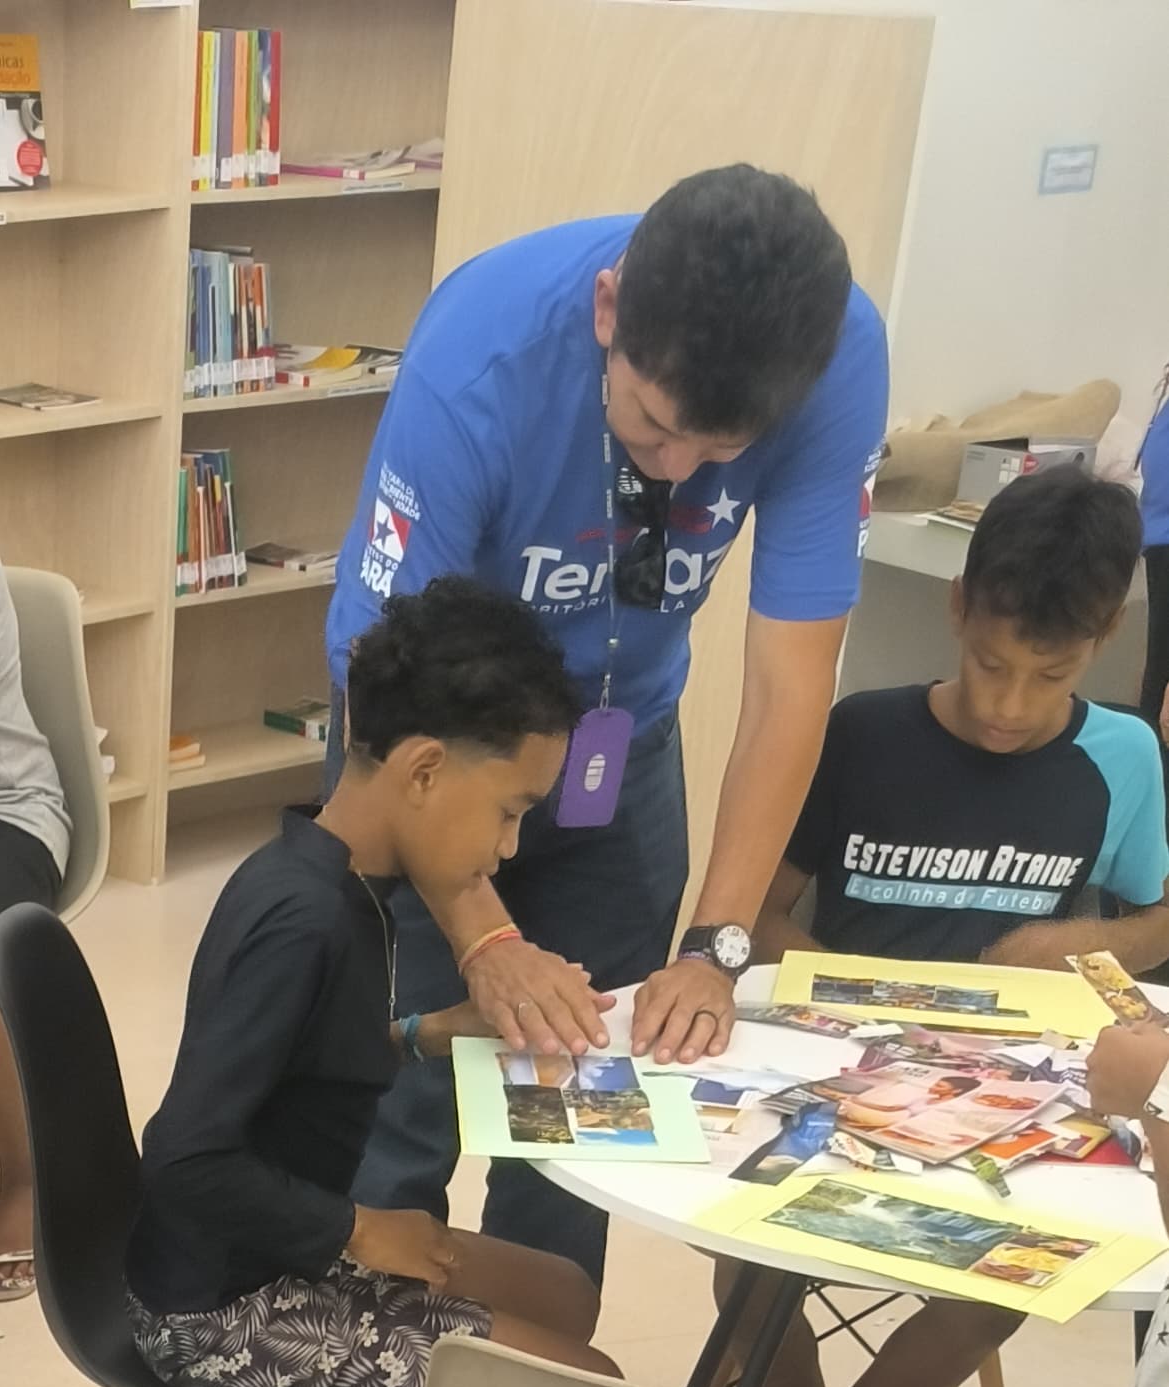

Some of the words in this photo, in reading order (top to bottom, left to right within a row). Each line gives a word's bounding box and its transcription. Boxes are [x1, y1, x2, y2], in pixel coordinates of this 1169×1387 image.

[843, 833, 988, 881] ESTEVISON
[986, 844, 1084, 888] ATAIDE
[849, 878, 945, 904] Escolinha
